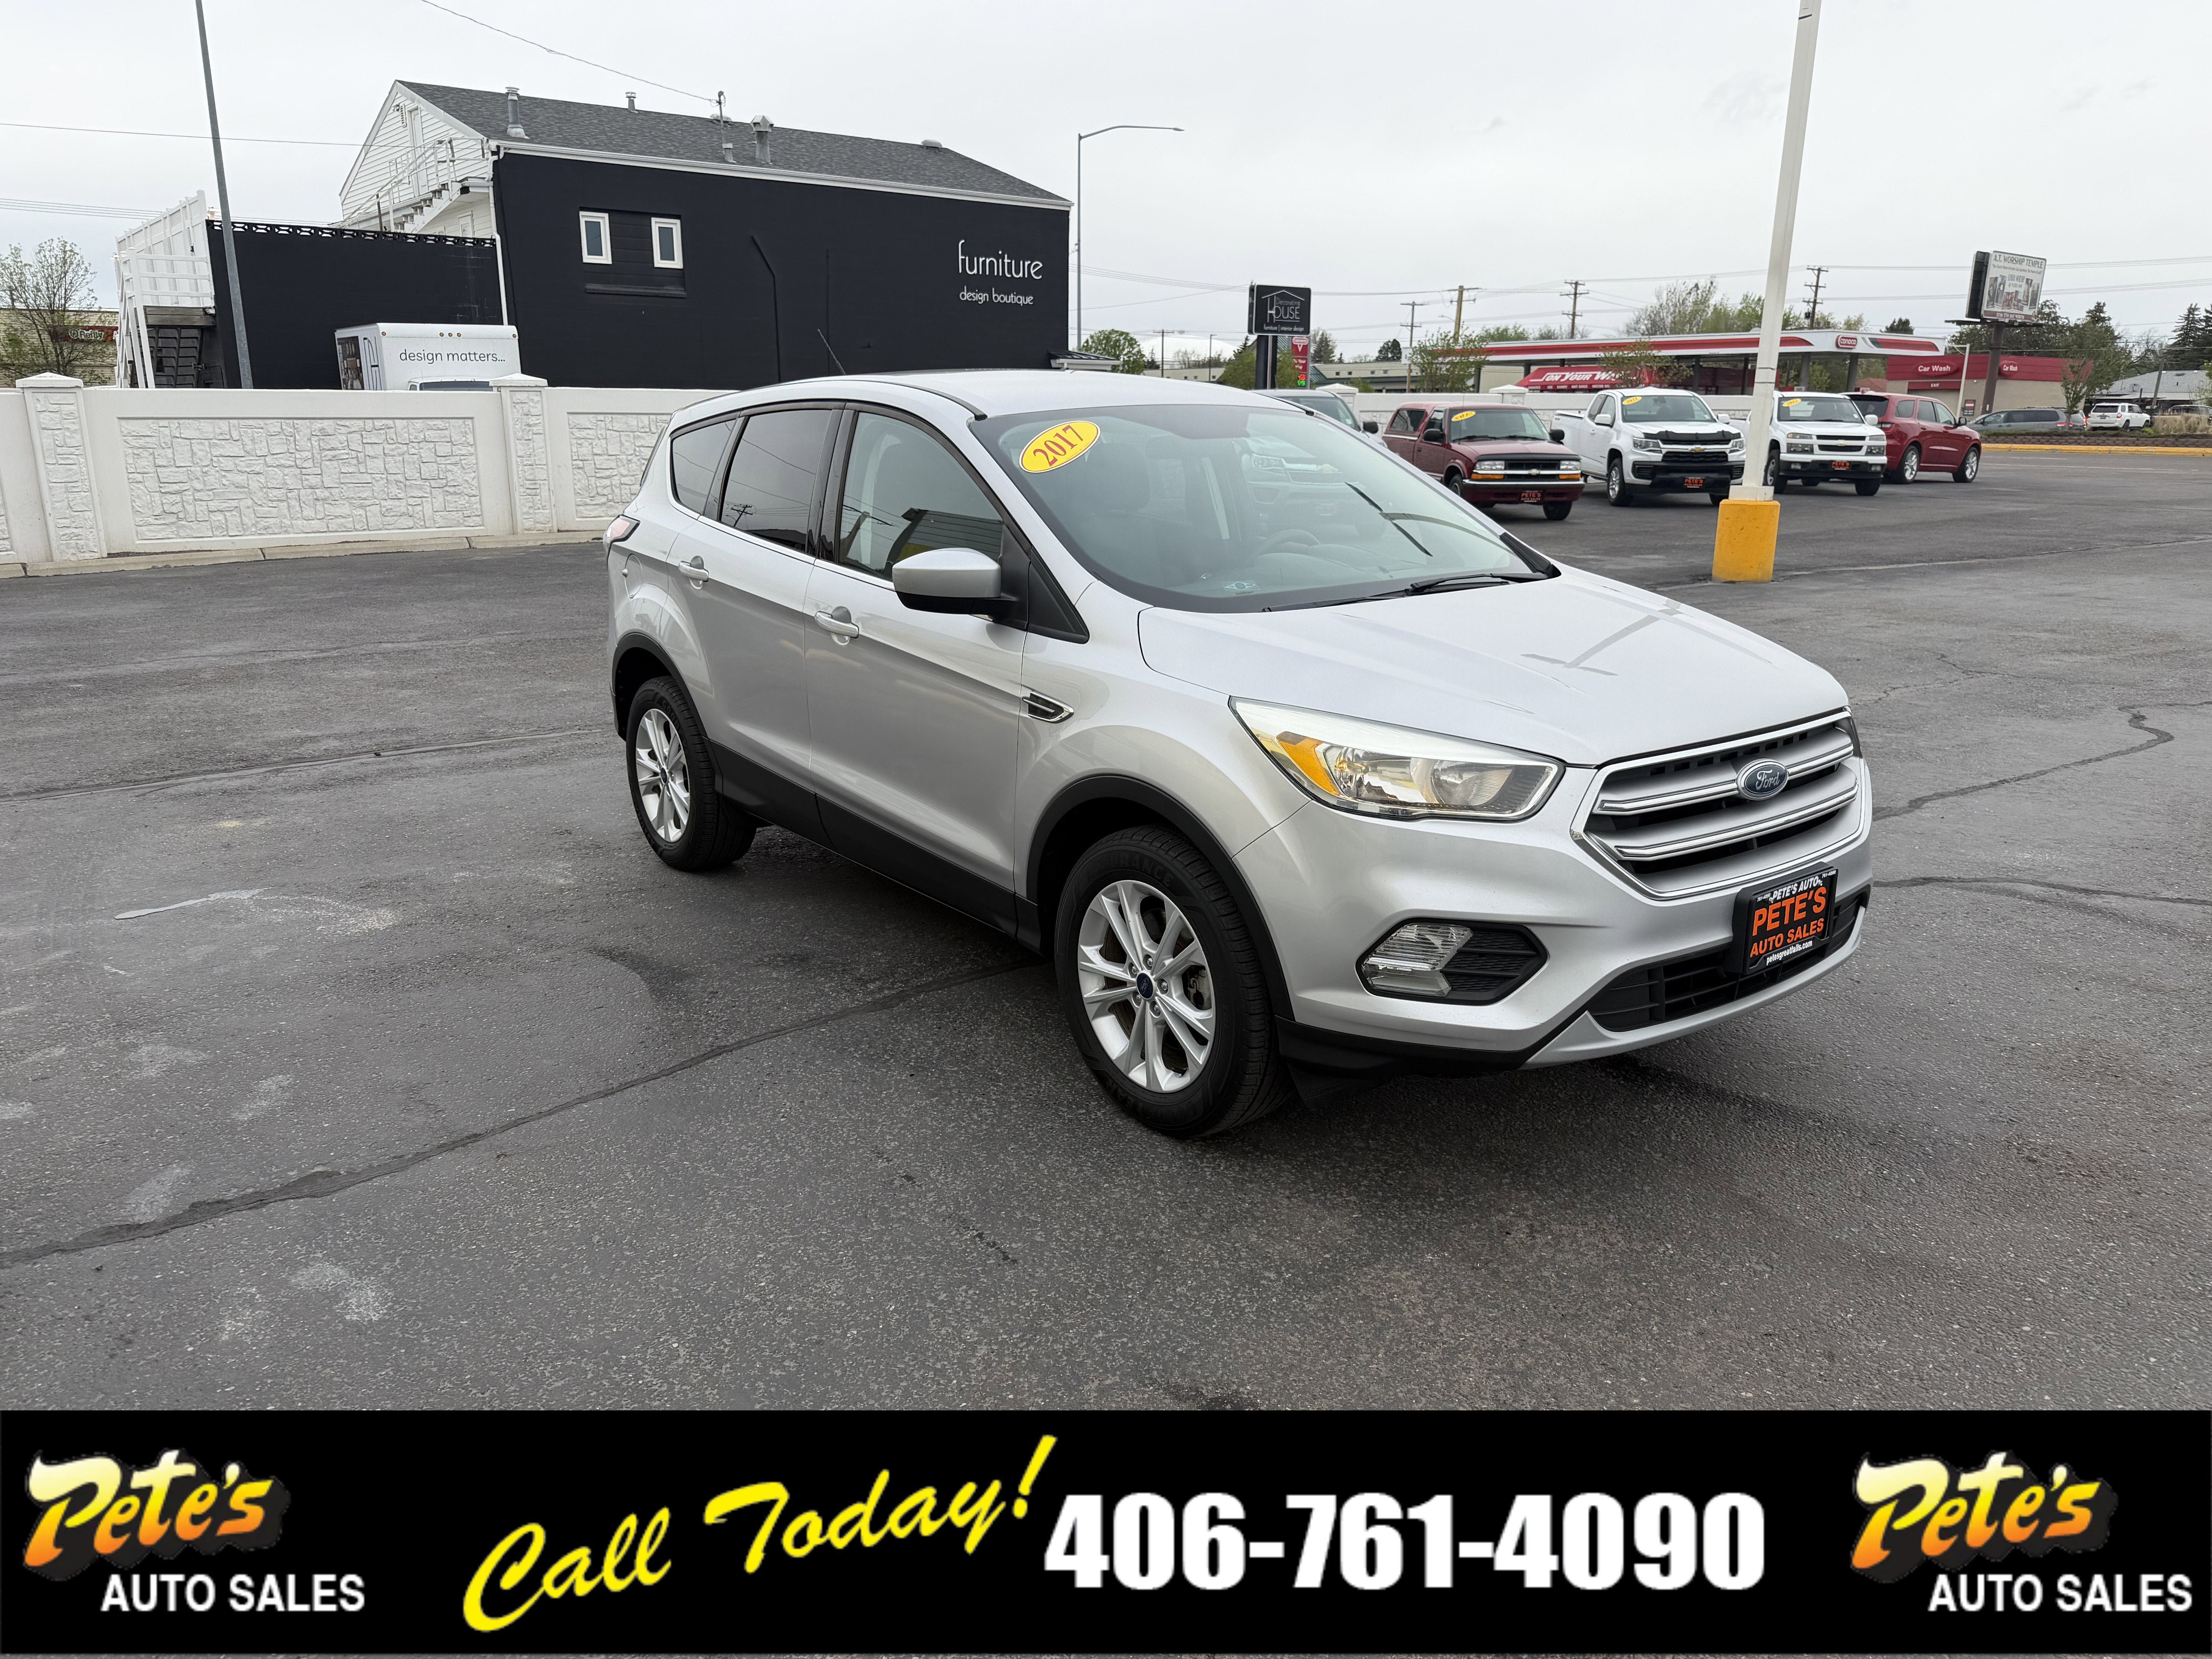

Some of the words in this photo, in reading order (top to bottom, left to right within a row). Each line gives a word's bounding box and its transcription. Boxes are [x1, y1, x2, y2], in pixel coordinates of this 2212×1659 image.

[958, 240, 1043, 279] furniture
[2004, 255, 2025, 265] WORSHIP
[2026, 259, 2044, 269] TEMPLE
[959, 285, 989, 304] design
[992, 287, 1034, 306] boutique
[1267, 295, 1300, 323] HOUSE
[400, 349, 443, 364] design
[447, 349, 505, 362] matters...
[1033, 425, 1083, 467] 2017
[1755, 769, 1780, 790] Ford
[1772, 883, 1798, 900] PETE'S
[1798, 876, 1819, 892] AUTO
[1752, 886, 1827, 936] PETE'S
[1750, 933, 1784, 958] AUTO
[1787, 918, 1824, 943] SALES
[1766, 940, 1813, 966] petesgreatfalls.com
